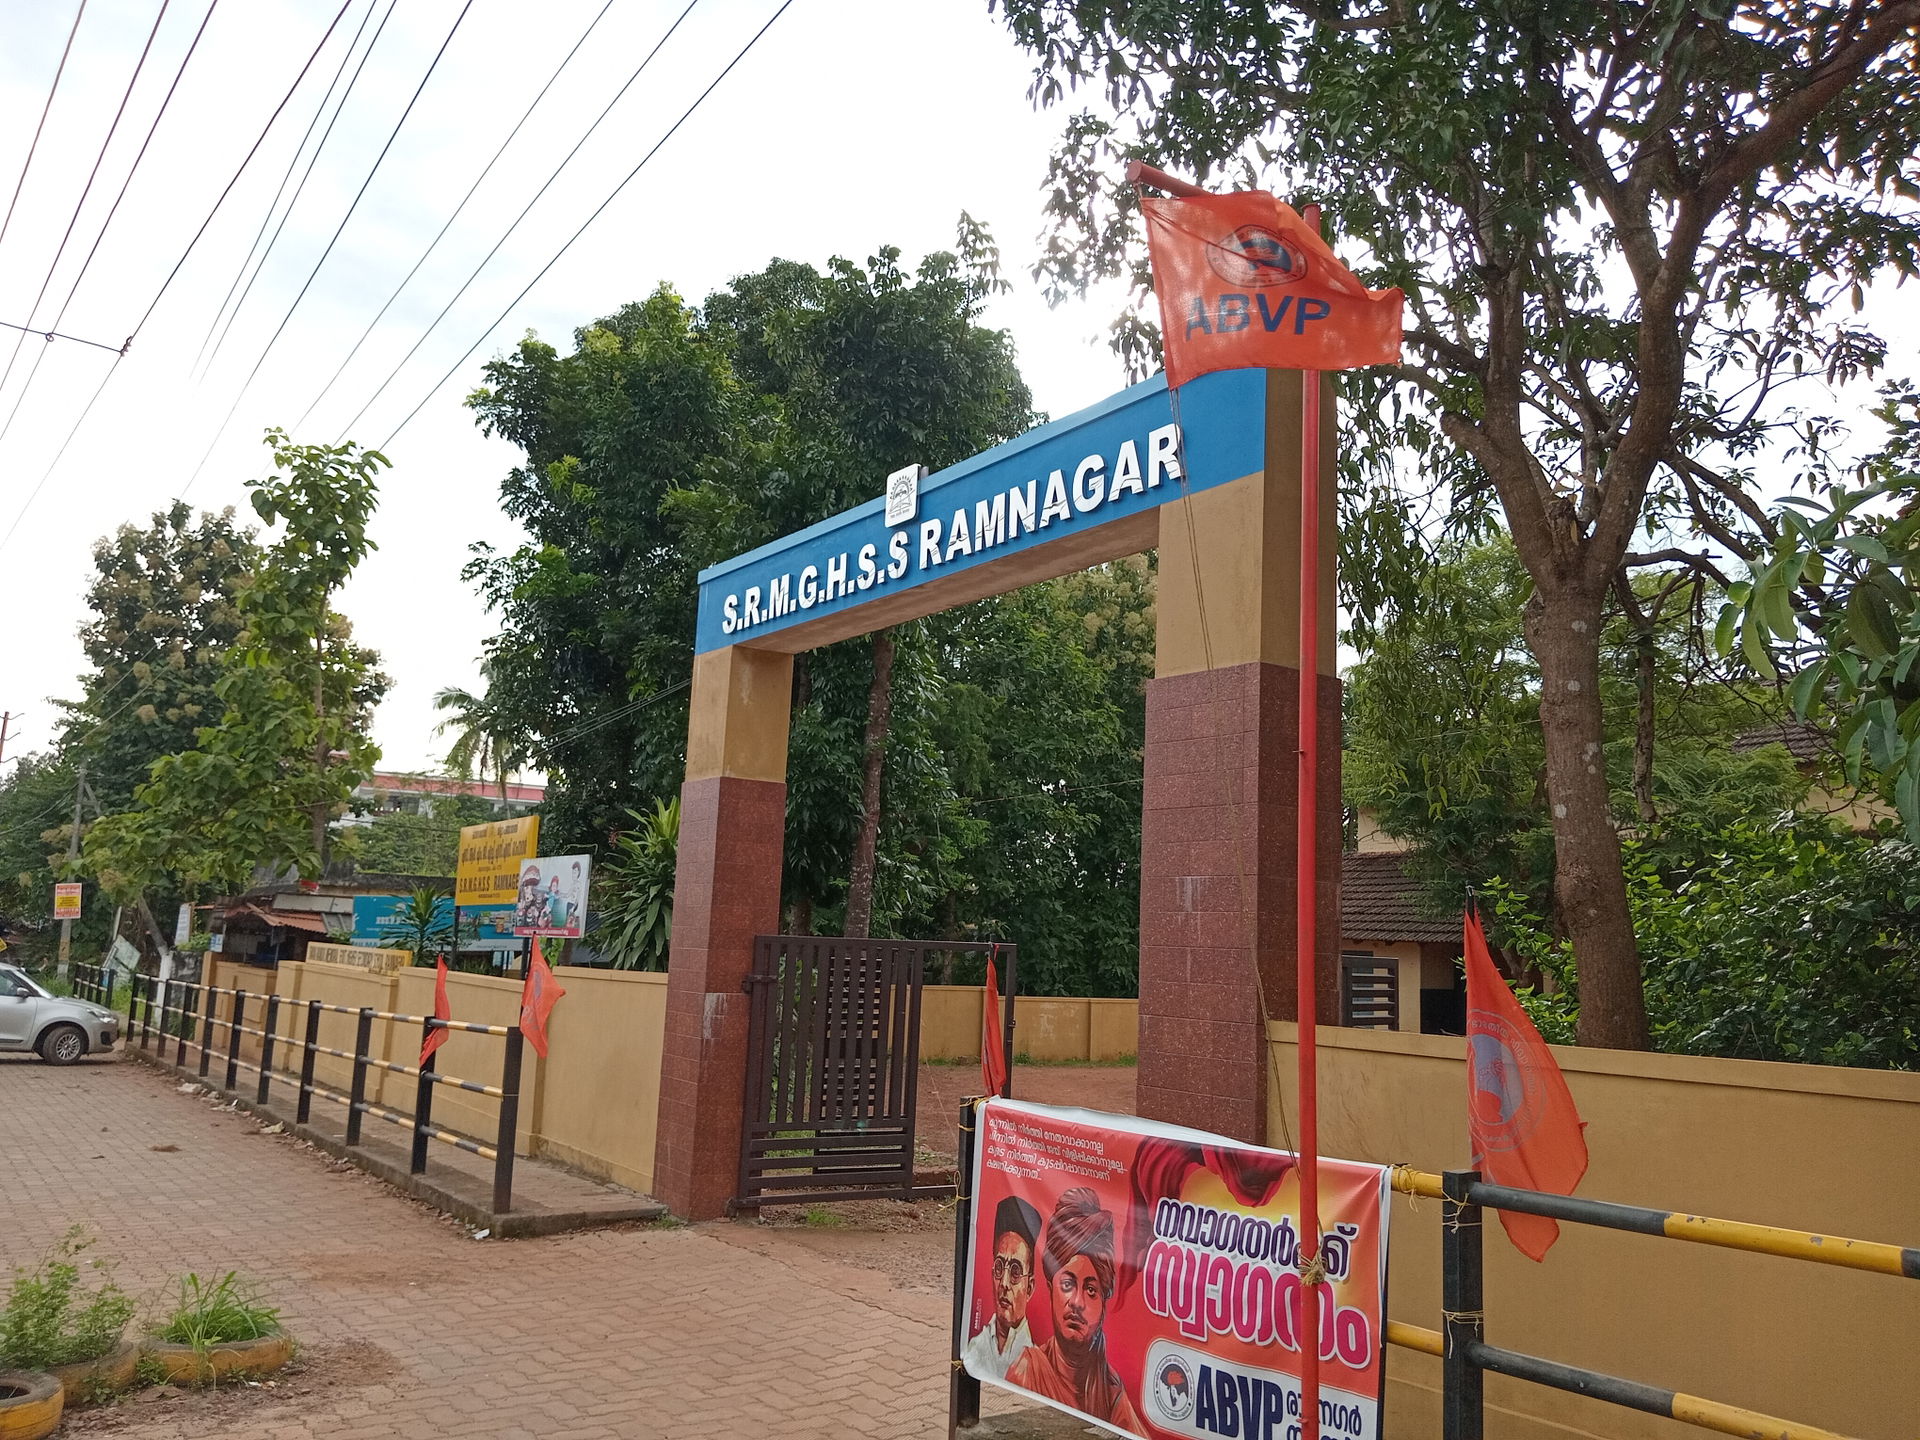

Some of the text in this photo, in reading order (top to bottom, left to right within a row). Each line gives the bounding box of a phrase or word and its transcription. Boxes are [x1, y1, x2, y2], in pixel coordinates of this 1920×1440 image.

[1185, 293, 1331, 342] ABVP
[721, 423, 1183, 635] S.R.M.G.H.S.S RAMNAGAR
[1196, 1364, 1284, 1440] ABVP
